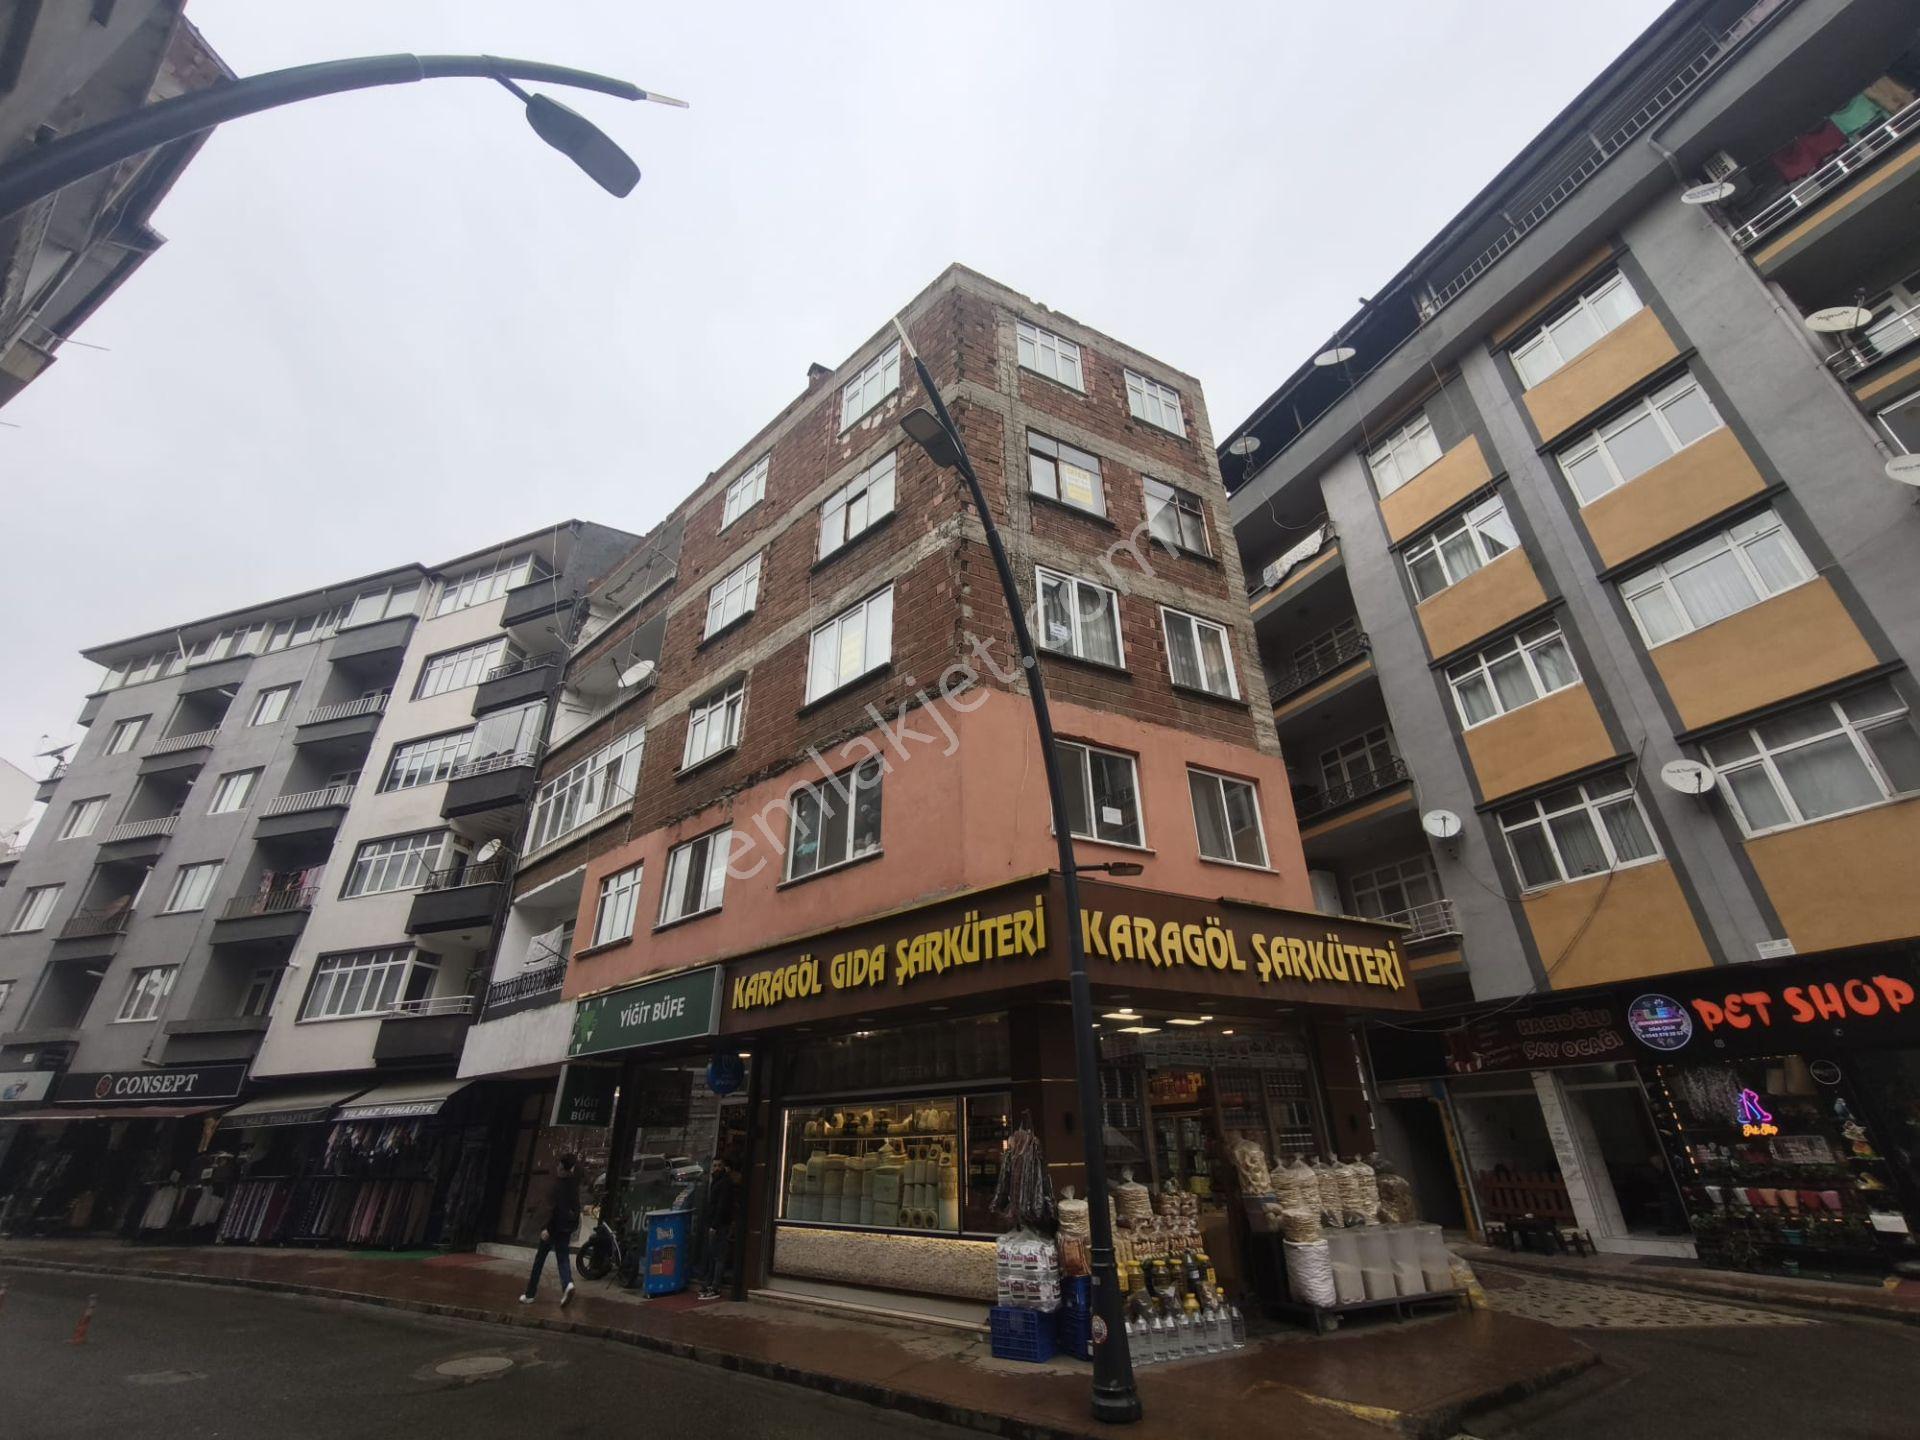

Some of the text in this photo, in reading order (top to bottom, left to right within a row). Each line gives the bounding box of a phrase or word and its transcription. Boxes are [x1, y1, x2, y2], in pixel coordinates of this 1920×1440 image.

[732, 894, 1046, 1010] KARAGÖL GIDA ŞARKÜTERİ
[1080, 909, 1406, 991] KARAGÖL ŞARKÜTERİ
[619, 995, 686, 1028] YİĞİT BÜFE
[1692, 975, 1915, 1031] PET SHOP
[1516, 1007, 1612, 1036] HACIOĞLU
[1522, 1040, 1560, 1060] ÇAY
[1561, 1028, 1625, 1058] OCAĞI
[115, 1074, 199, 1095] CONSEPT
[343, 1107, 379, 1119] YILMAZ
